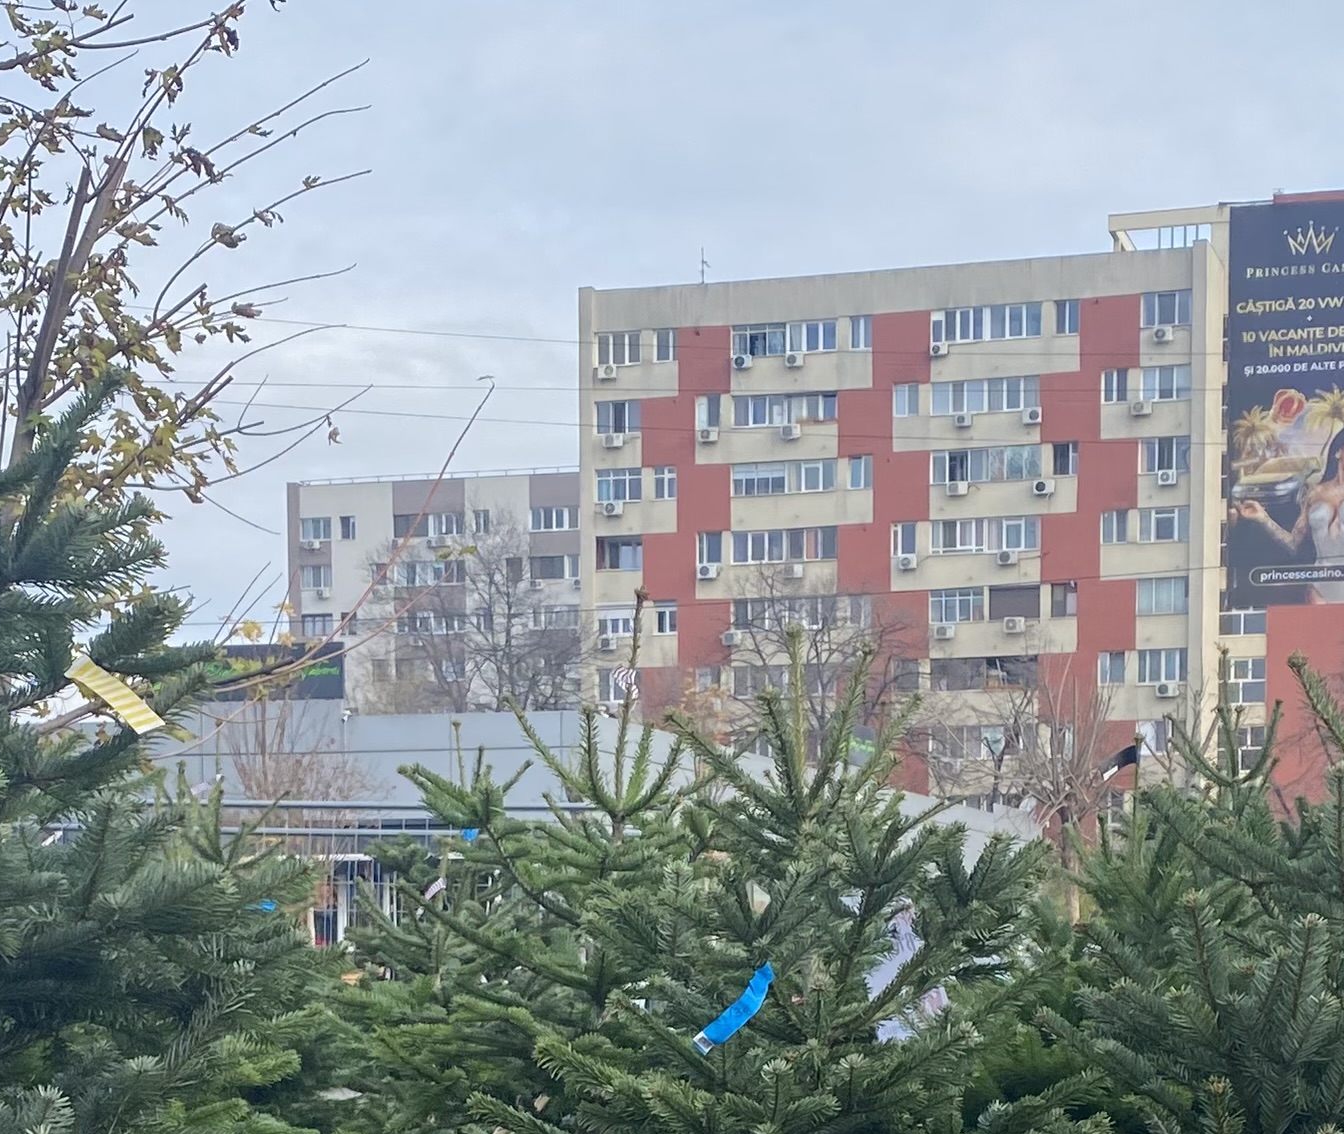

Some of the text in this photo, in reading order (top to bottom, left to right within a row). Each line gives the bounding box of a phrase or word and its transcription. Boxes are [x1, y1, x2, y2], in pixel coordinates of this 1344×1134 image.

[1246, 264, 1315, 279] PRINCESS
[1318, 295, 1344, 308] VW
[1242, 331, 1256, 343] 10
[1269, 343, 1284, 358] ÎN
[1293, 362, 1308, 372] DE
[1310, 360, 1336, 371] ALTE
